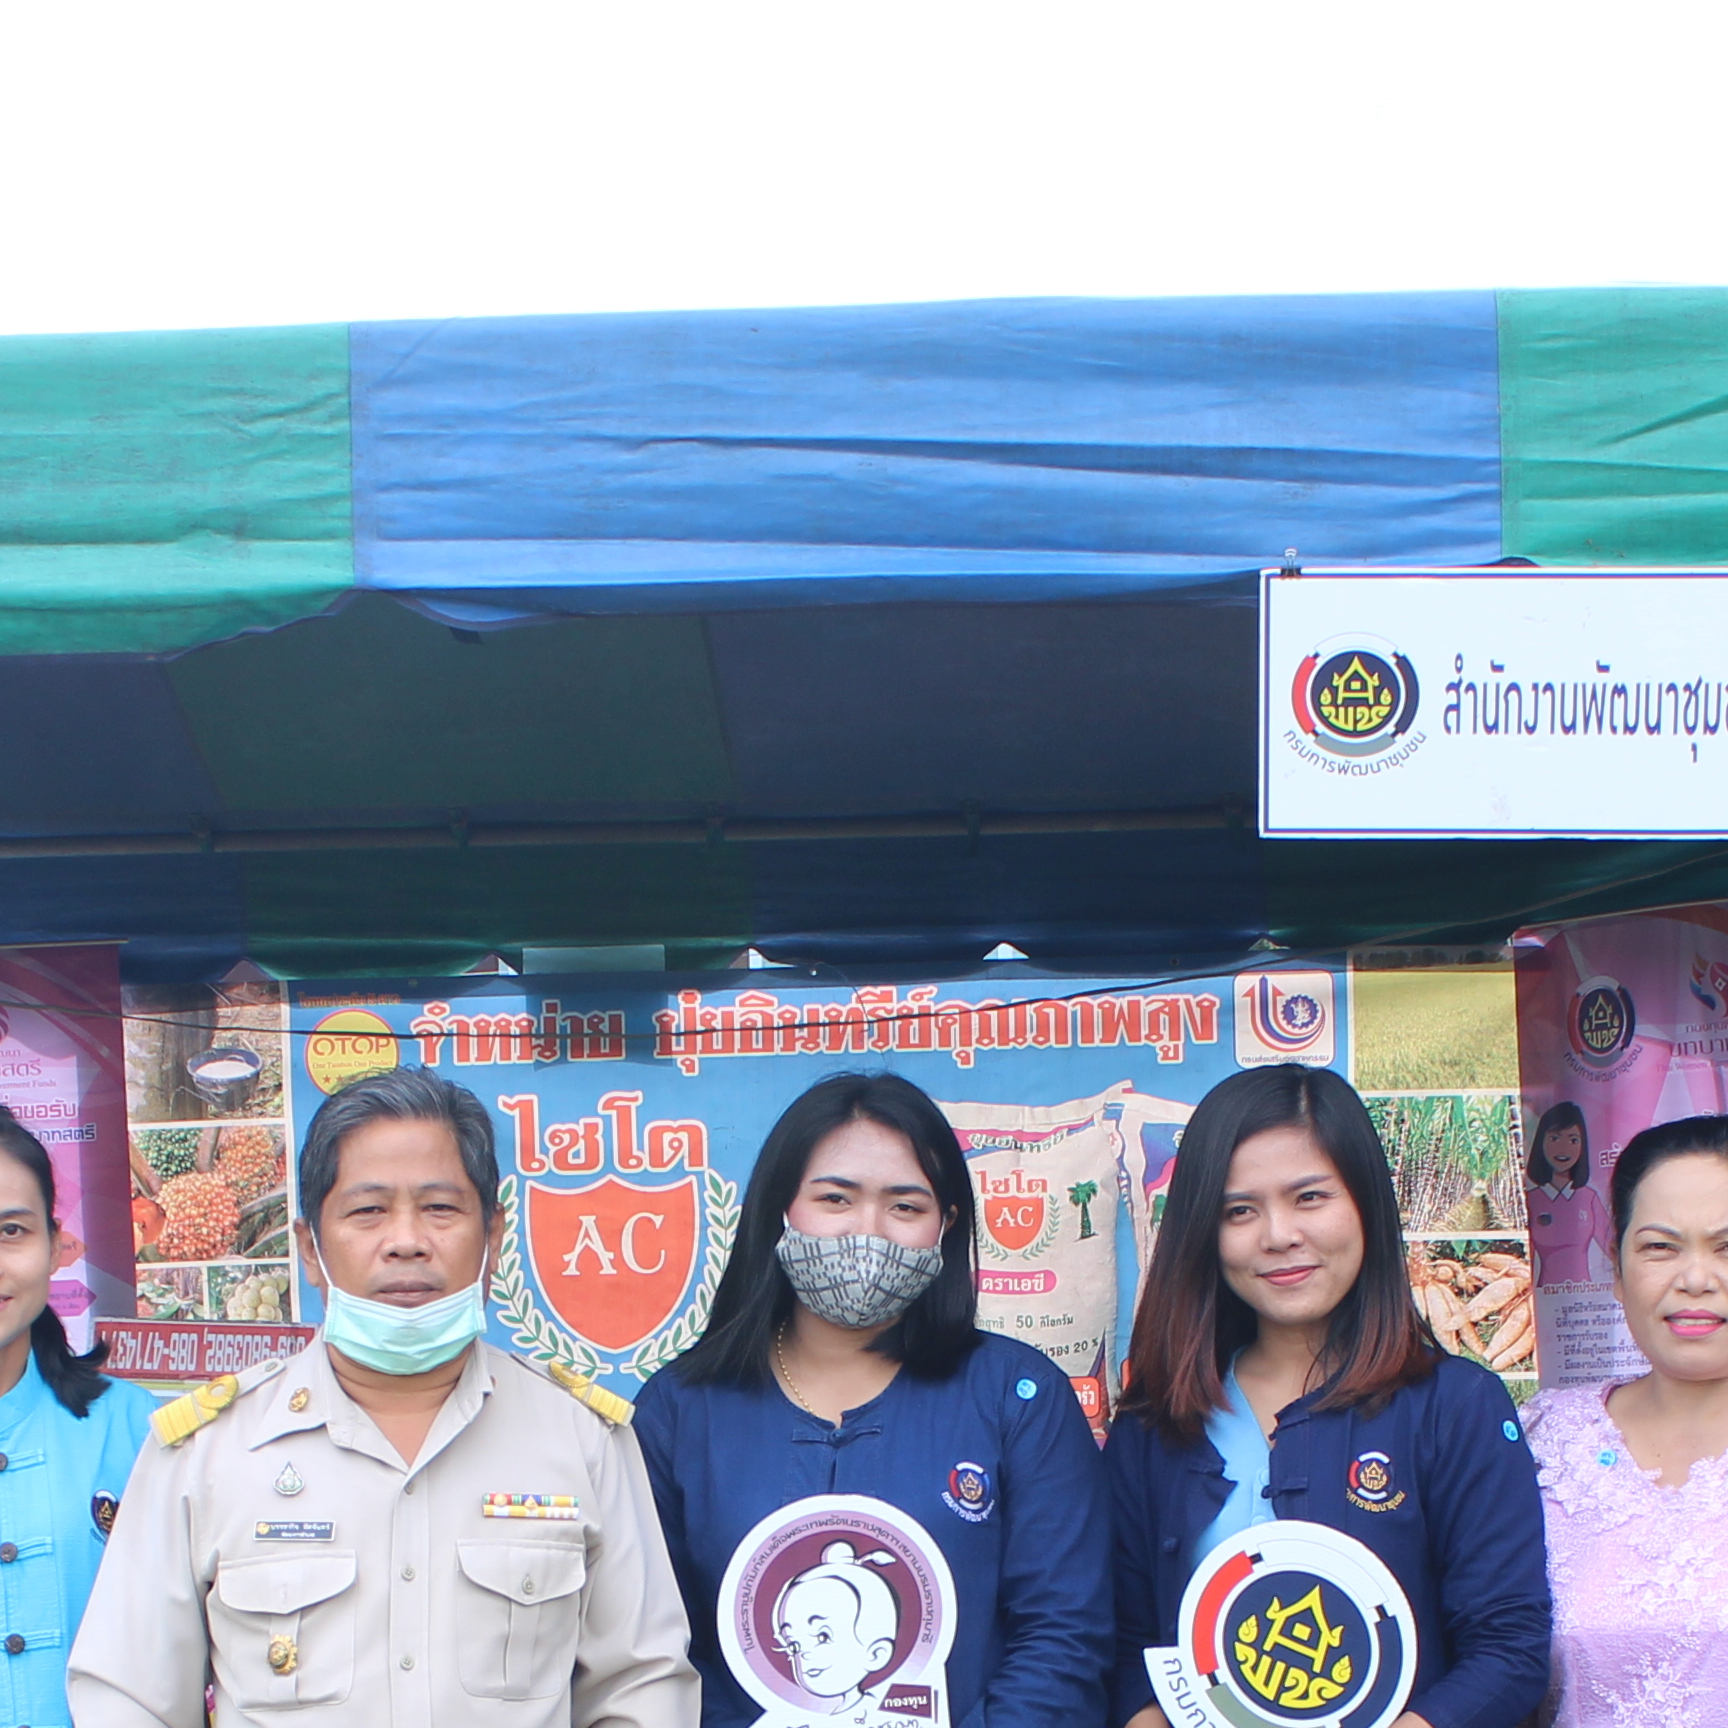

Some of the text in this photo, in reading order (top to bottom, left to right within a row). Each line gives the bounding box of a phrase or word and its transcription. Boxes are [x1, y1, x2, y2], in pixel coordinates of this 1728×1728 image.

[1284, 730, 1427, 776] กรมการพัฒนาชุมชน
[411, 985, 1218, 1077] จำหน่าย ปุ๋ยอินทรีย์คุณภาพสูง
[312, 1036, 391, 1057] OTOP
[499, 1091, 708, 1177] ไซโต
[995, 1205, 1035, 1229] AC
[561, 1211, 666, 1277] AC
[982, 1272, 1045, 1292] ตราเอซี
[1015, 1315, 1034, 1329] 50
[1039, 1314, 1074, 1328] กิโลกรัม
[1073, 1340, 1089, 1354] 20
[884, 1693, 928, 1711] กองทุน
